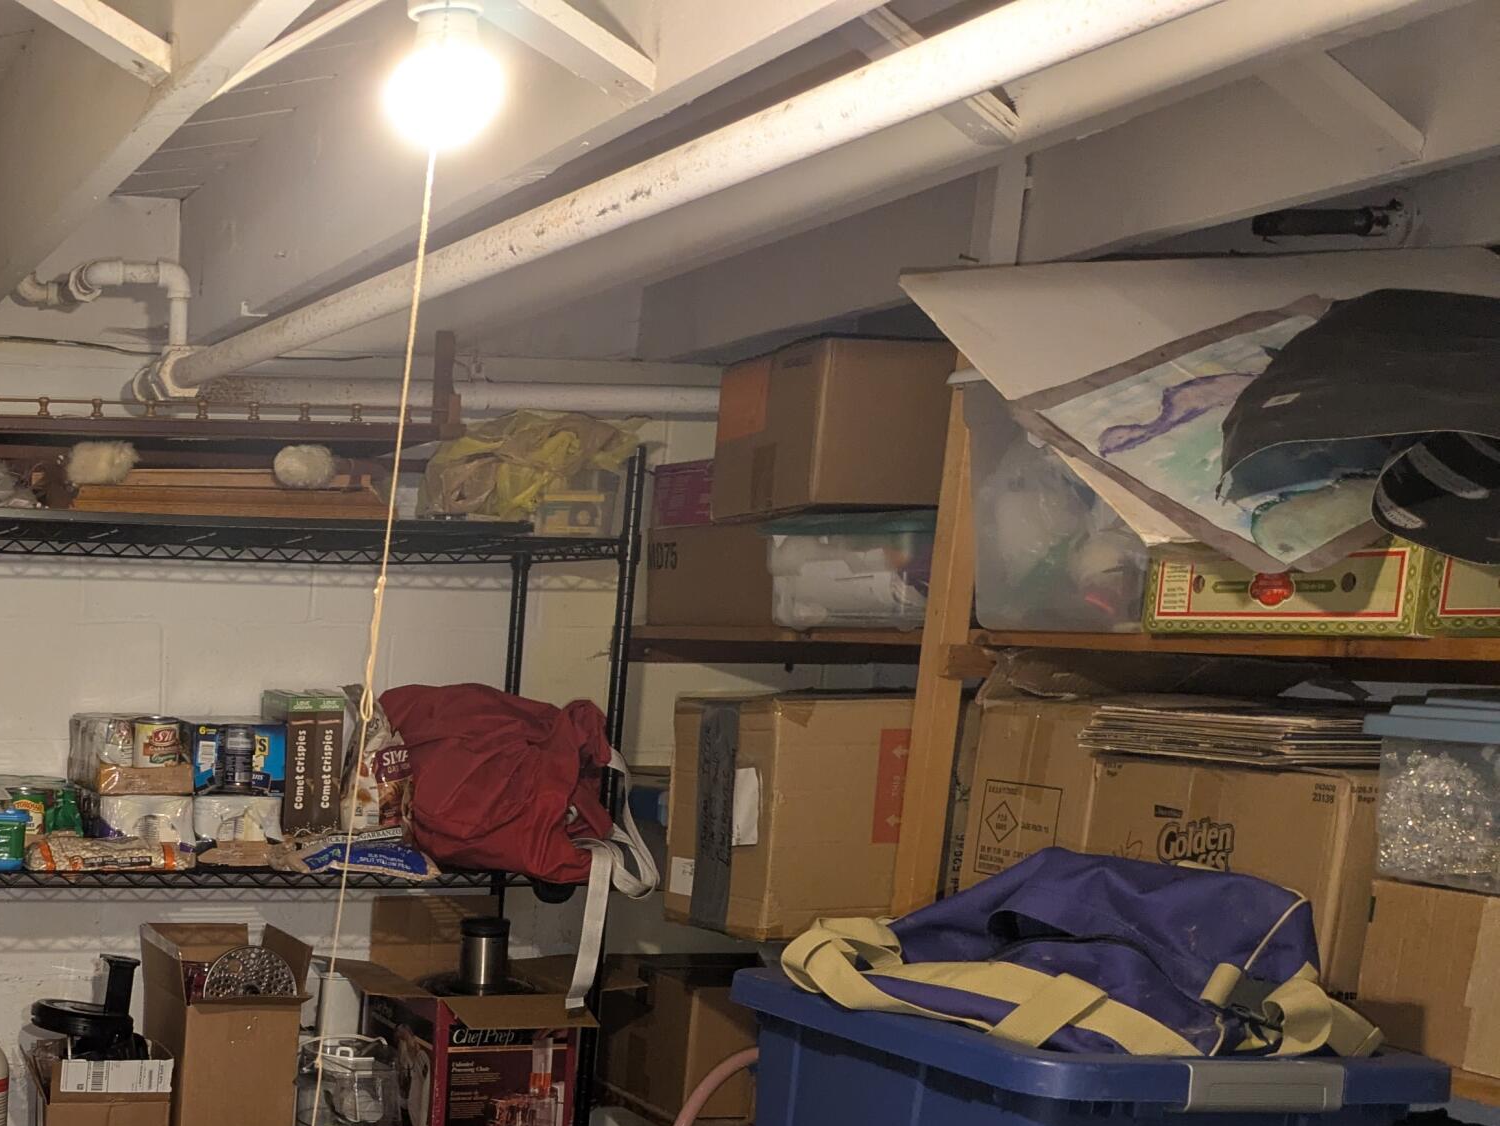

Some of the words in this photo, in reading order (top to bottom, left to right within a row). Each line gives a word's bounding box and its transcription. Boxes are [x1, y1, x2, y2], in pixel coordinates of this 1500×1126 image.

[294, 776, 306, 810] Comet
[321, 776, 332, 809] Comet
[1157, 817, 1234, 863] Golden
